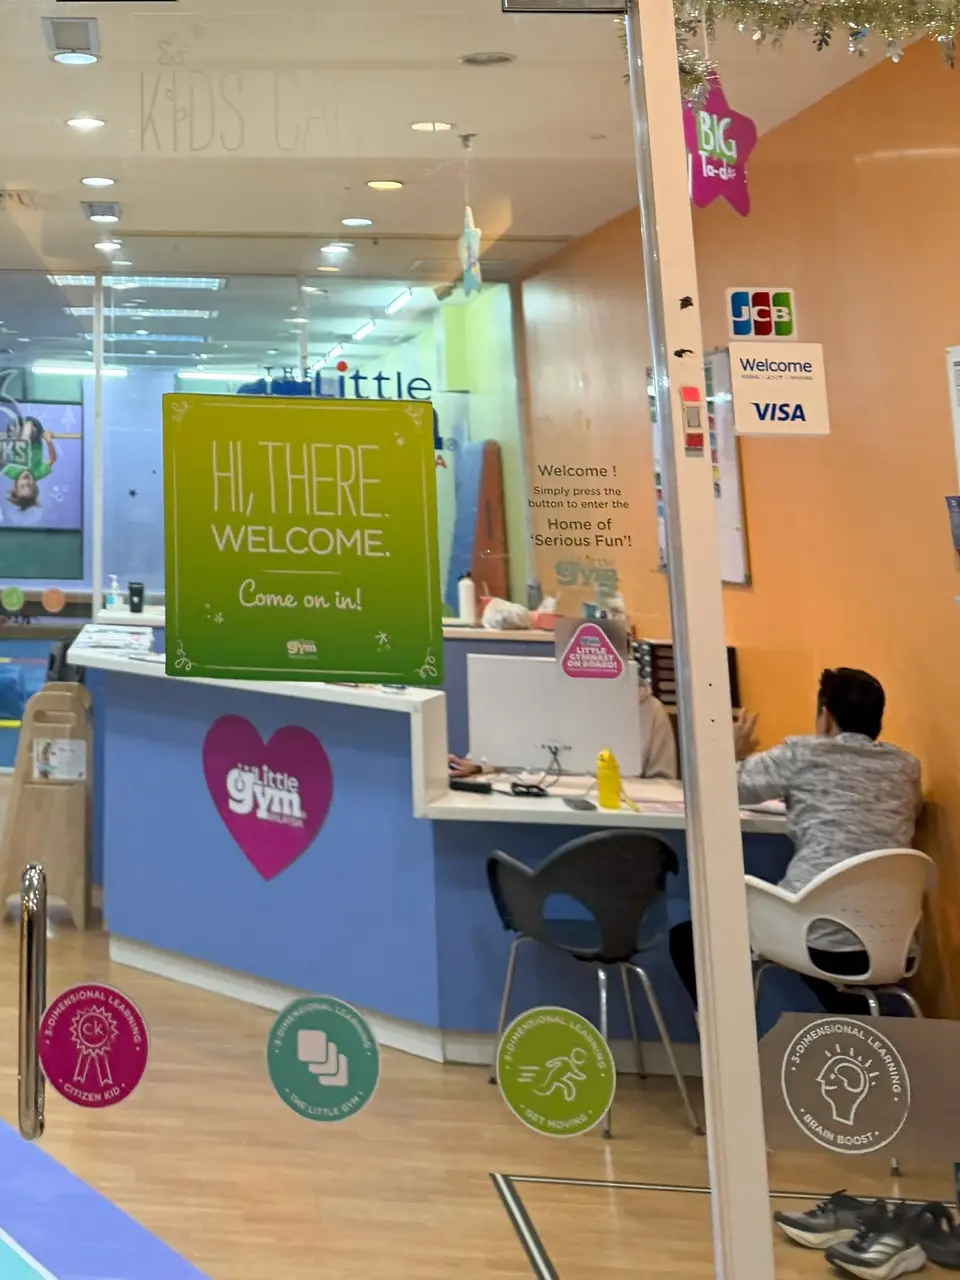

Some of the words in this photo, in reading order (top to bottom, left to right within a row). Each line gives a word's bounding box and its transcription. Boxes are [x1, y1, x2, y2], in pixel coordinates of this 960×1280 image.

[140, 70, 245, 153] KIDS
[699, 111, 737, 158] BIG
[314, 360, 433, 401] Little
[739, 357, 813, 373] Welcome
[750, 402, 807, 422] VISA
[211, 440, 255, 517] HI,
[257, 441, 391, 518] THERE.
[537, 464, 608, 477] Welcome
[527, 498, 564, 509] button
[567, 500, 578, 509] to
[580, 500, 609, 509] enter
[612, 500, 630, 509] the
[533, 486, 570, 497] Simply
[573, 488, 601, 496] press
[604, 487, 622, 496] the
[547, 518, 592, 531] Home
[596, 517, 613, 531] of
[210, 523, 391, 558] WELCOME.
[238, 578, 298, 608] Come
[303, 593, 330, 609] on
[335, 587, 363, 612] in!
[226, 767, 303, 820] gym
[253, 764, 300, 793] Little
[44, 989, 107, 1038] 3-DIMENSIONAL
[107, 995, 142, 1044] LEARNING
[568, 1021, 607, 1069] LEARNING
[791, 1024, 866, 1064] 3-DIMENSIONAL
[867, 1036, 902, 1094] LEARNING
[63, 1082, 102, 1101] CITIZEN
[103, 1086, 121, 1100] KID
[290, 1093, 309, 1110] THE
[308, 1105, 340, 1116] LITTLE
[341, 1095, 360, 1113] GYM
[524, 1108, 546, 1125] GET
[547, 1114, 588, 1129] MOVING
[802, 1113, 835, 1141] BRAIN
[836, 1131, 874, 1145] BOOST
